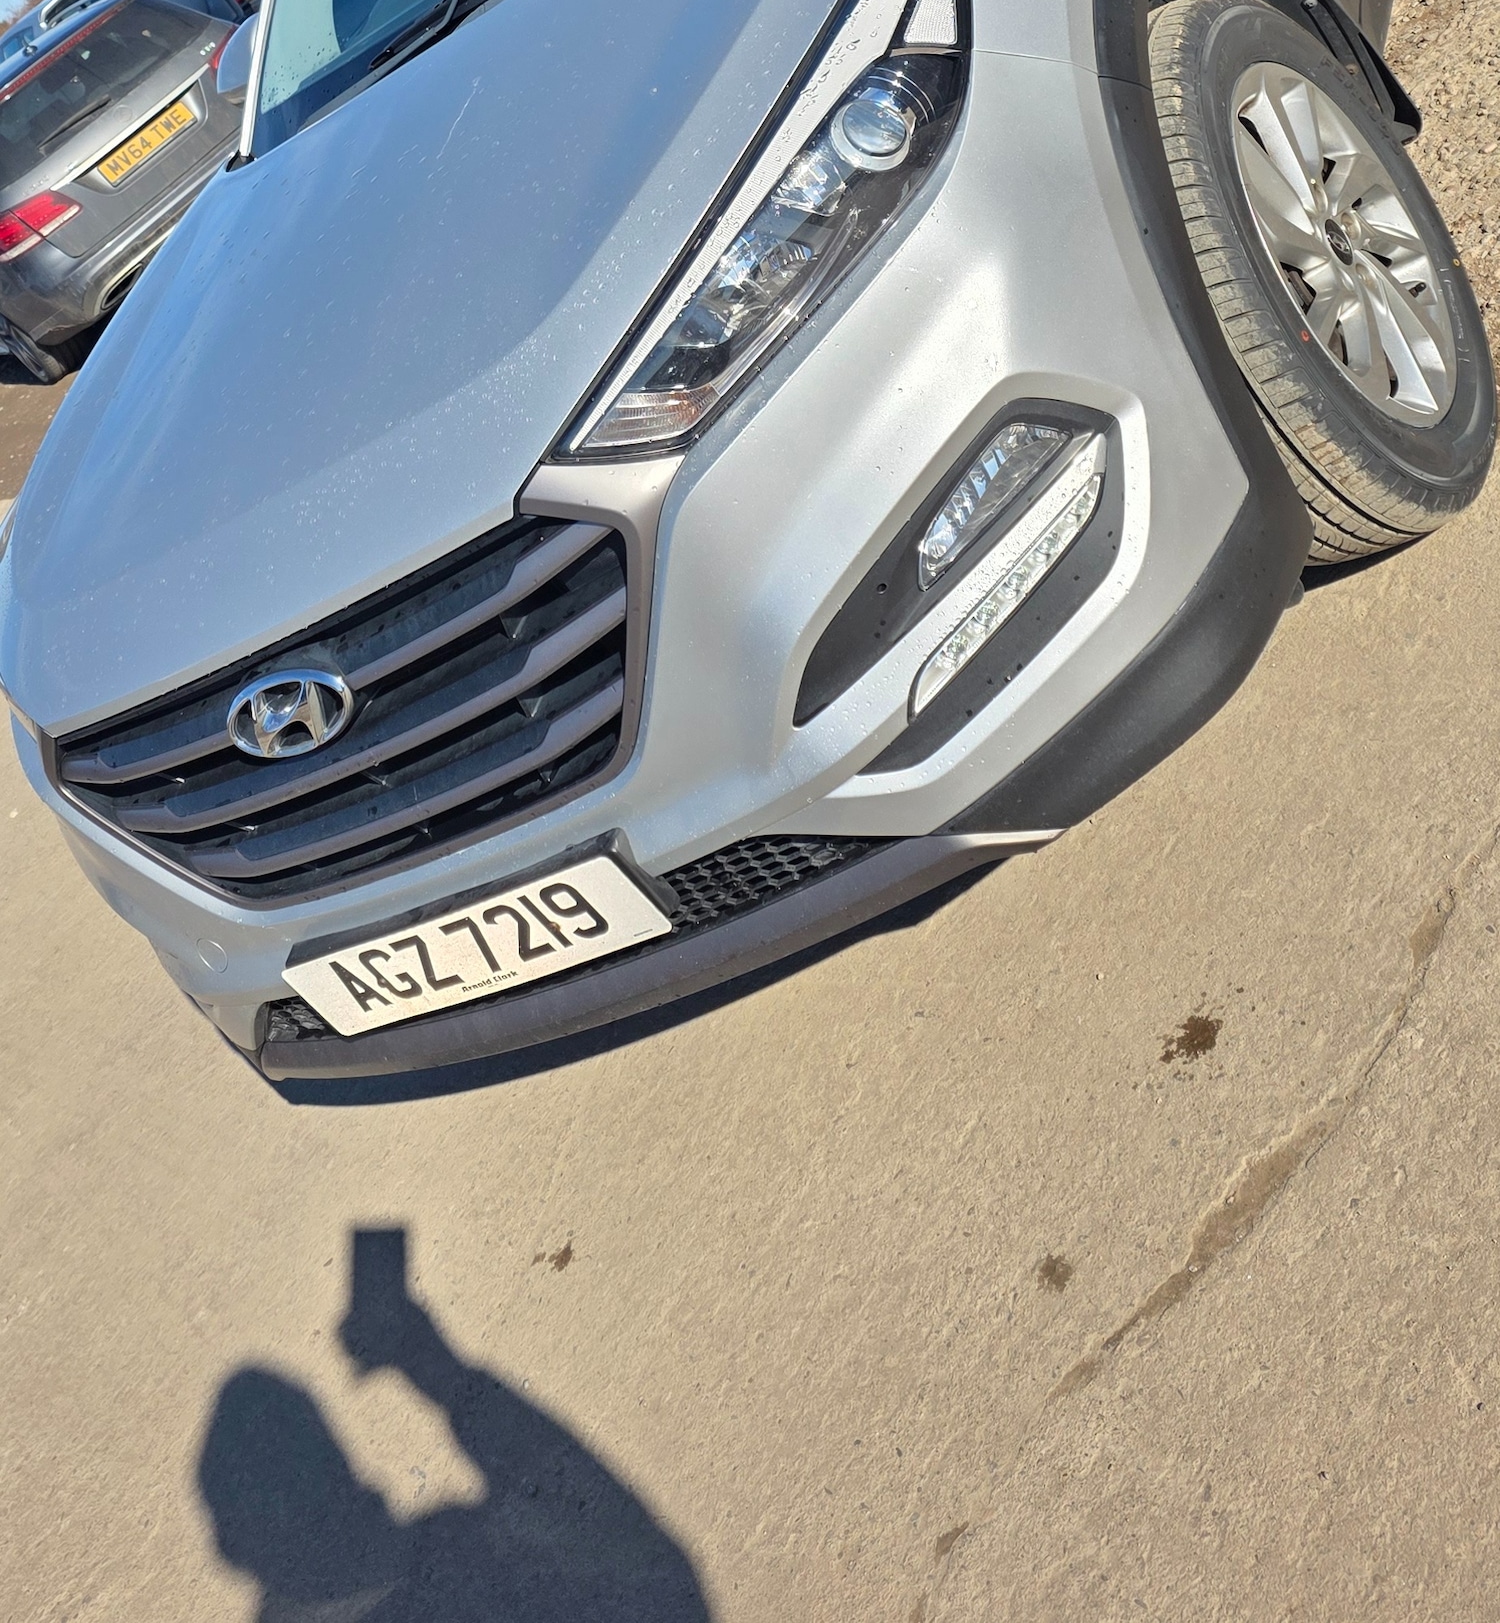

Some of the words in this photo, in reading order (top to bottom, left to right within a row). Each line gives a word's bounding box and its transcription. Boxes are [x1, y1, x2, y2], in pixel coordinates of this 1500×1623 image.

[106, 136, 153, 176] MV64
[149, 109, 187, 139] TWE
[328, 935, 465, 1013] AGZ
[438, 883, 609, 973] 7219
[462, 978, 493, 993] Arnold
